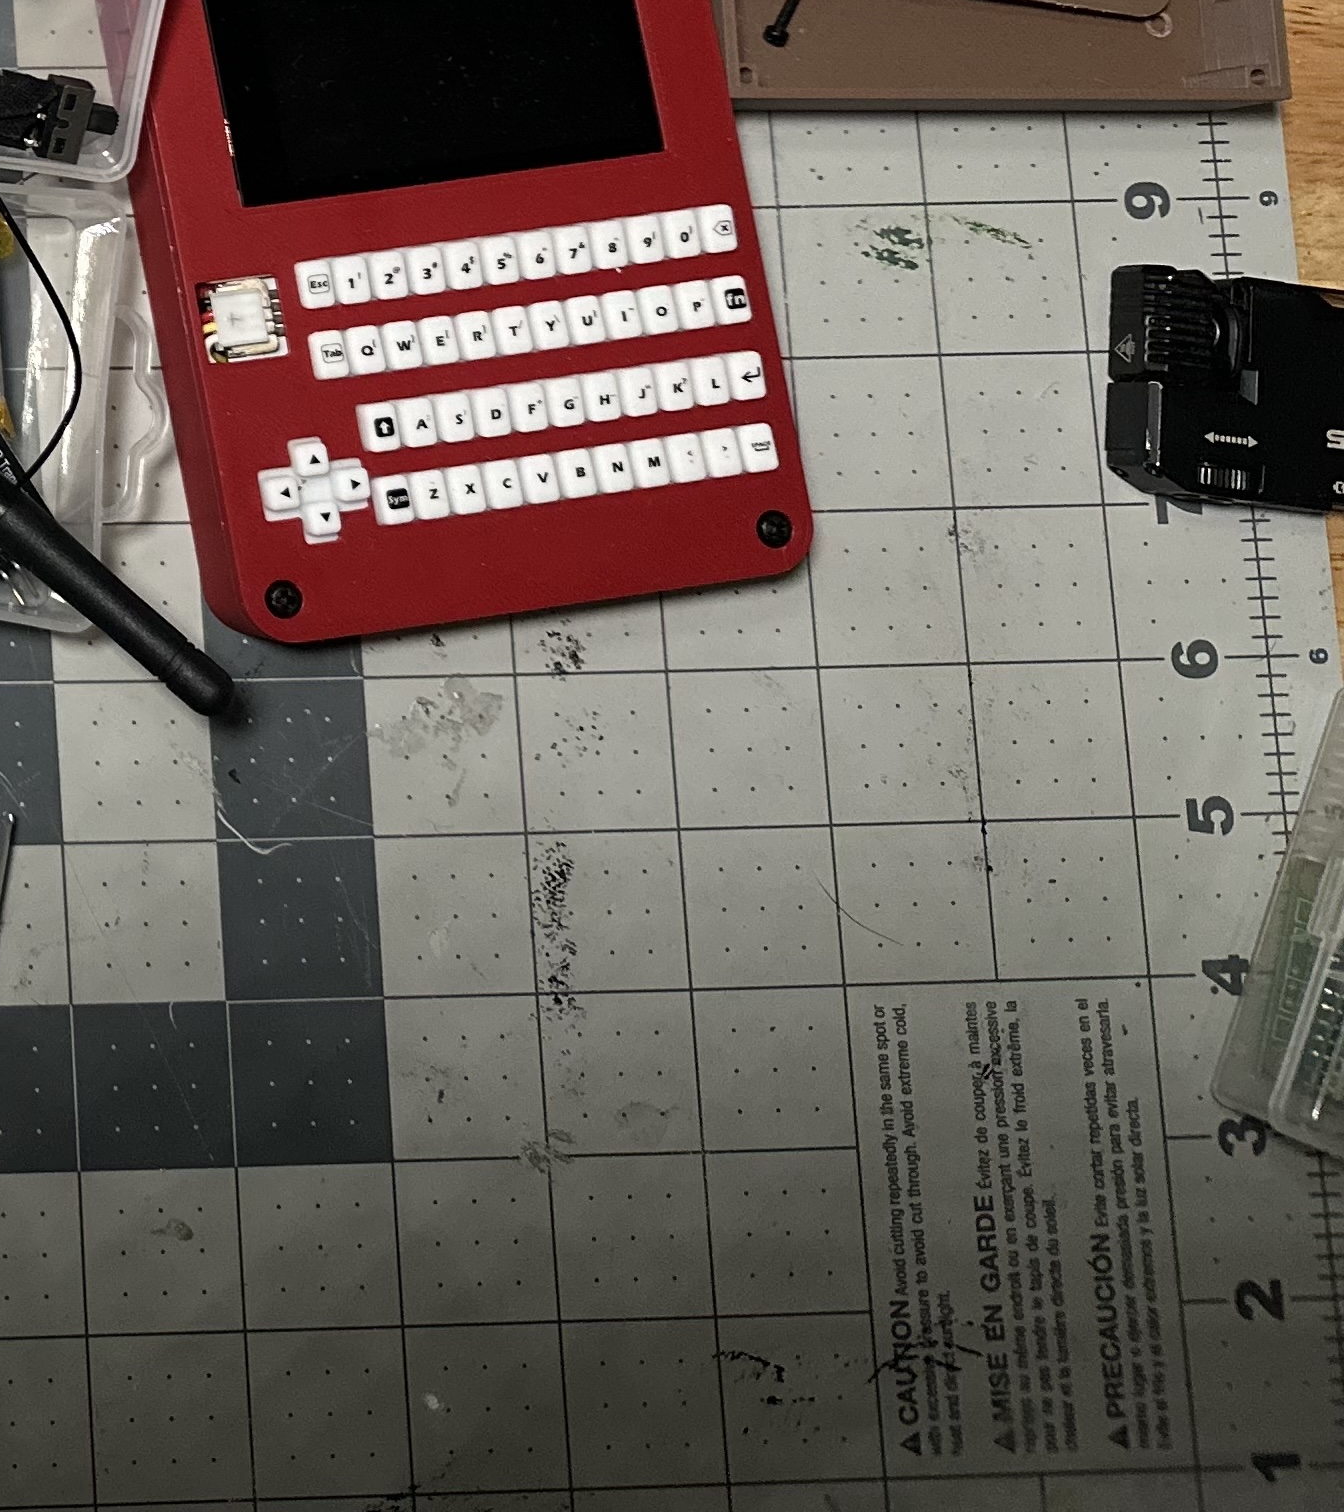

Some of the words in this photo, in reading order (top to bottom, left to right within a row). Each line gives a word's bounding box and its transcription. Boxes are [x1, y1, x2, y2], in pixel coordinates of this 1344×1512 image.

[387, 492, 409, 507] Sym
[1185, 793, 1235, 835] 5
[1201, 953, 1250, 996] 4
[873, 1020, 887, 1051] spot
[892, 1003, 907, 1035] cold,
[878, 1053, 892, 1091] same
[896, 1040, 913, 1096] extreme
[900, 1099, 916, 1139] Avoid
[1218, 1115, 1268, 1156] 3
[881, 1136, 902, 1205] repeatedly
[889, 1205, 905, 1255] cutting
[973, 1195, 1002, 1292] GARDE
[1233, 1277, 1286, 1322] 2
[889, 1299, 919, 1426] CAUTION
[1250, 1450, 1302, 1483] 1
